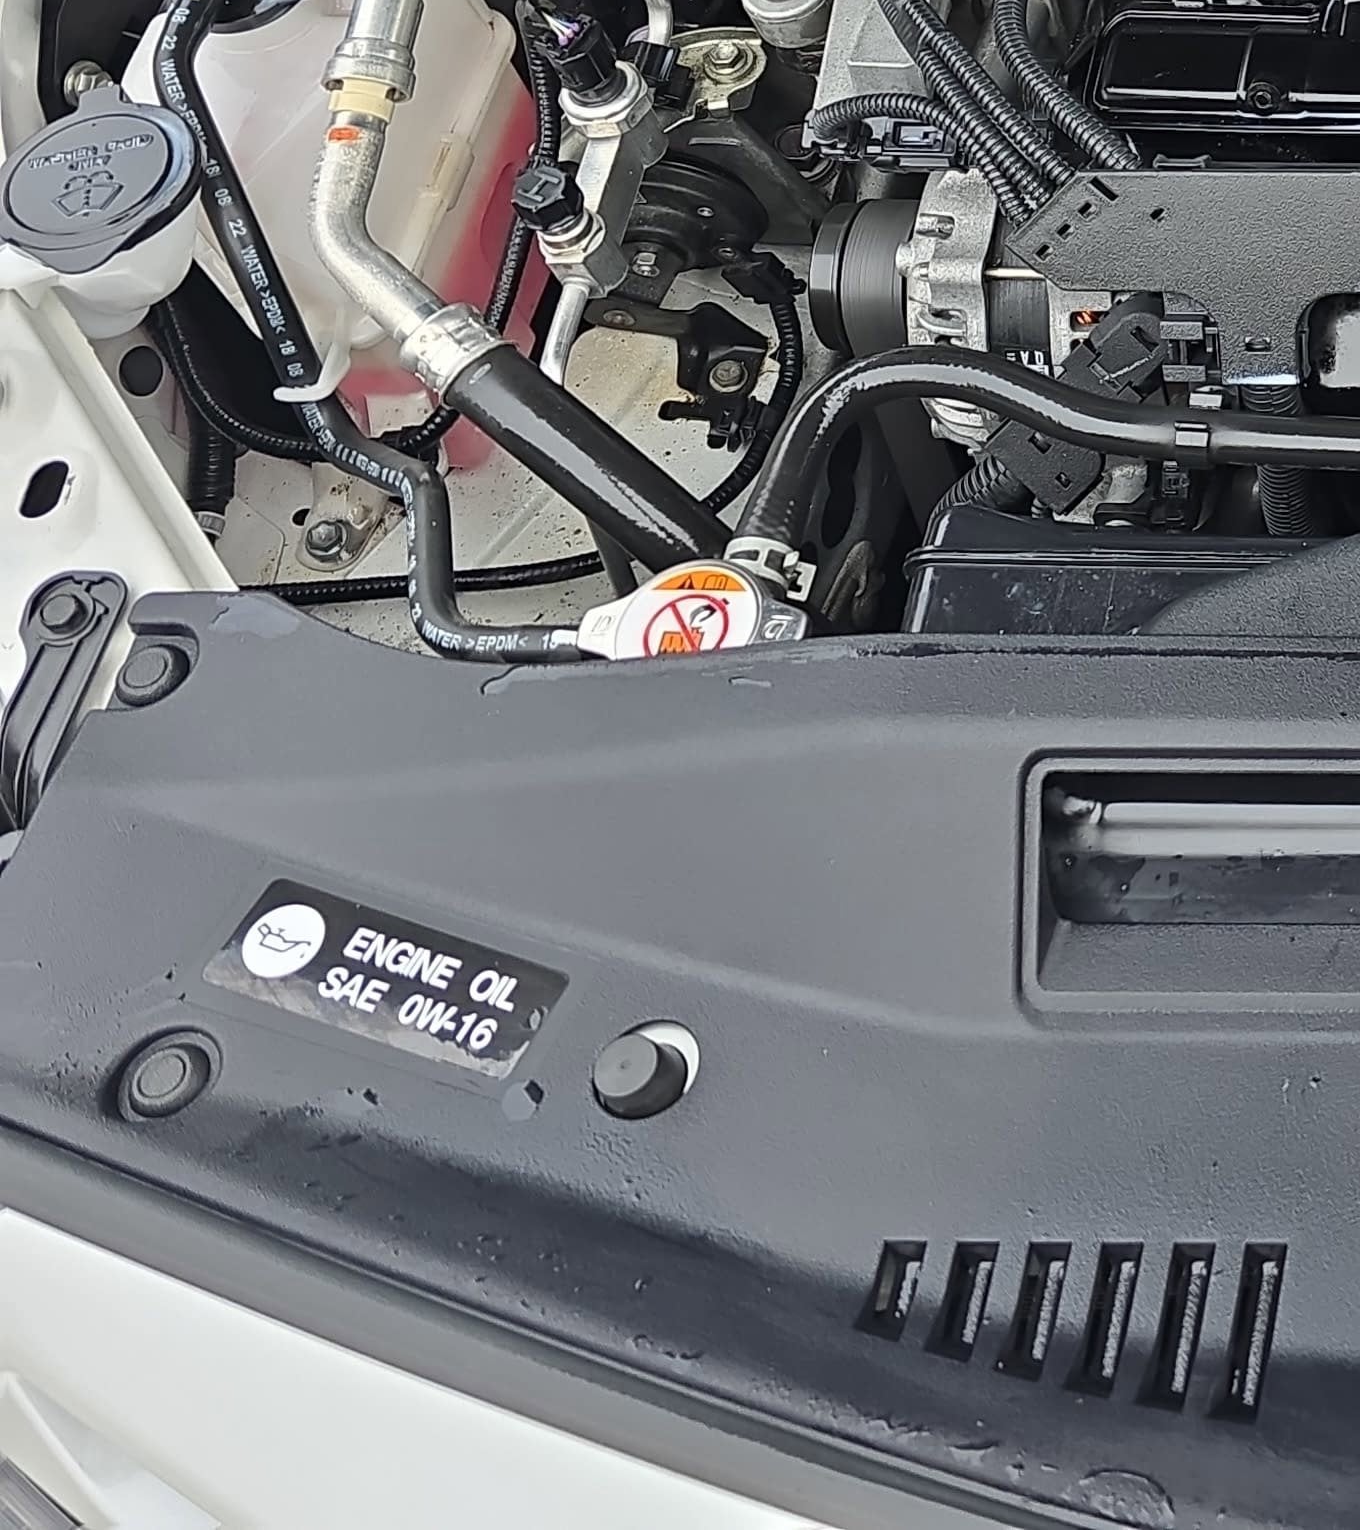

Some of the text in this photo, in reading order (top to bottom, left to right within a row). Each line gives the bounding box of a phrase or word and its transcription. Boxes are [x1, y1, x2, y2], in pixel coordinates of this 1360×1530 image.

[171, 7, 190, 24] 08
[161, 35, 177, 51] 22
[161, 58, 186, 103] WATER
[214, 188, 233, 206] 08
[228, 219, 247, 238] 22
[240, 245, 269, 290] WATER
[278, 340, 297, 356] 18
[421, 620, 462, 650] WATER
[464, 636, 529, 652] >EPDM<
[343, 927, 518, 1012] ENGINE OIL
[318, 967, 498, 1050] SAE 0W-16
